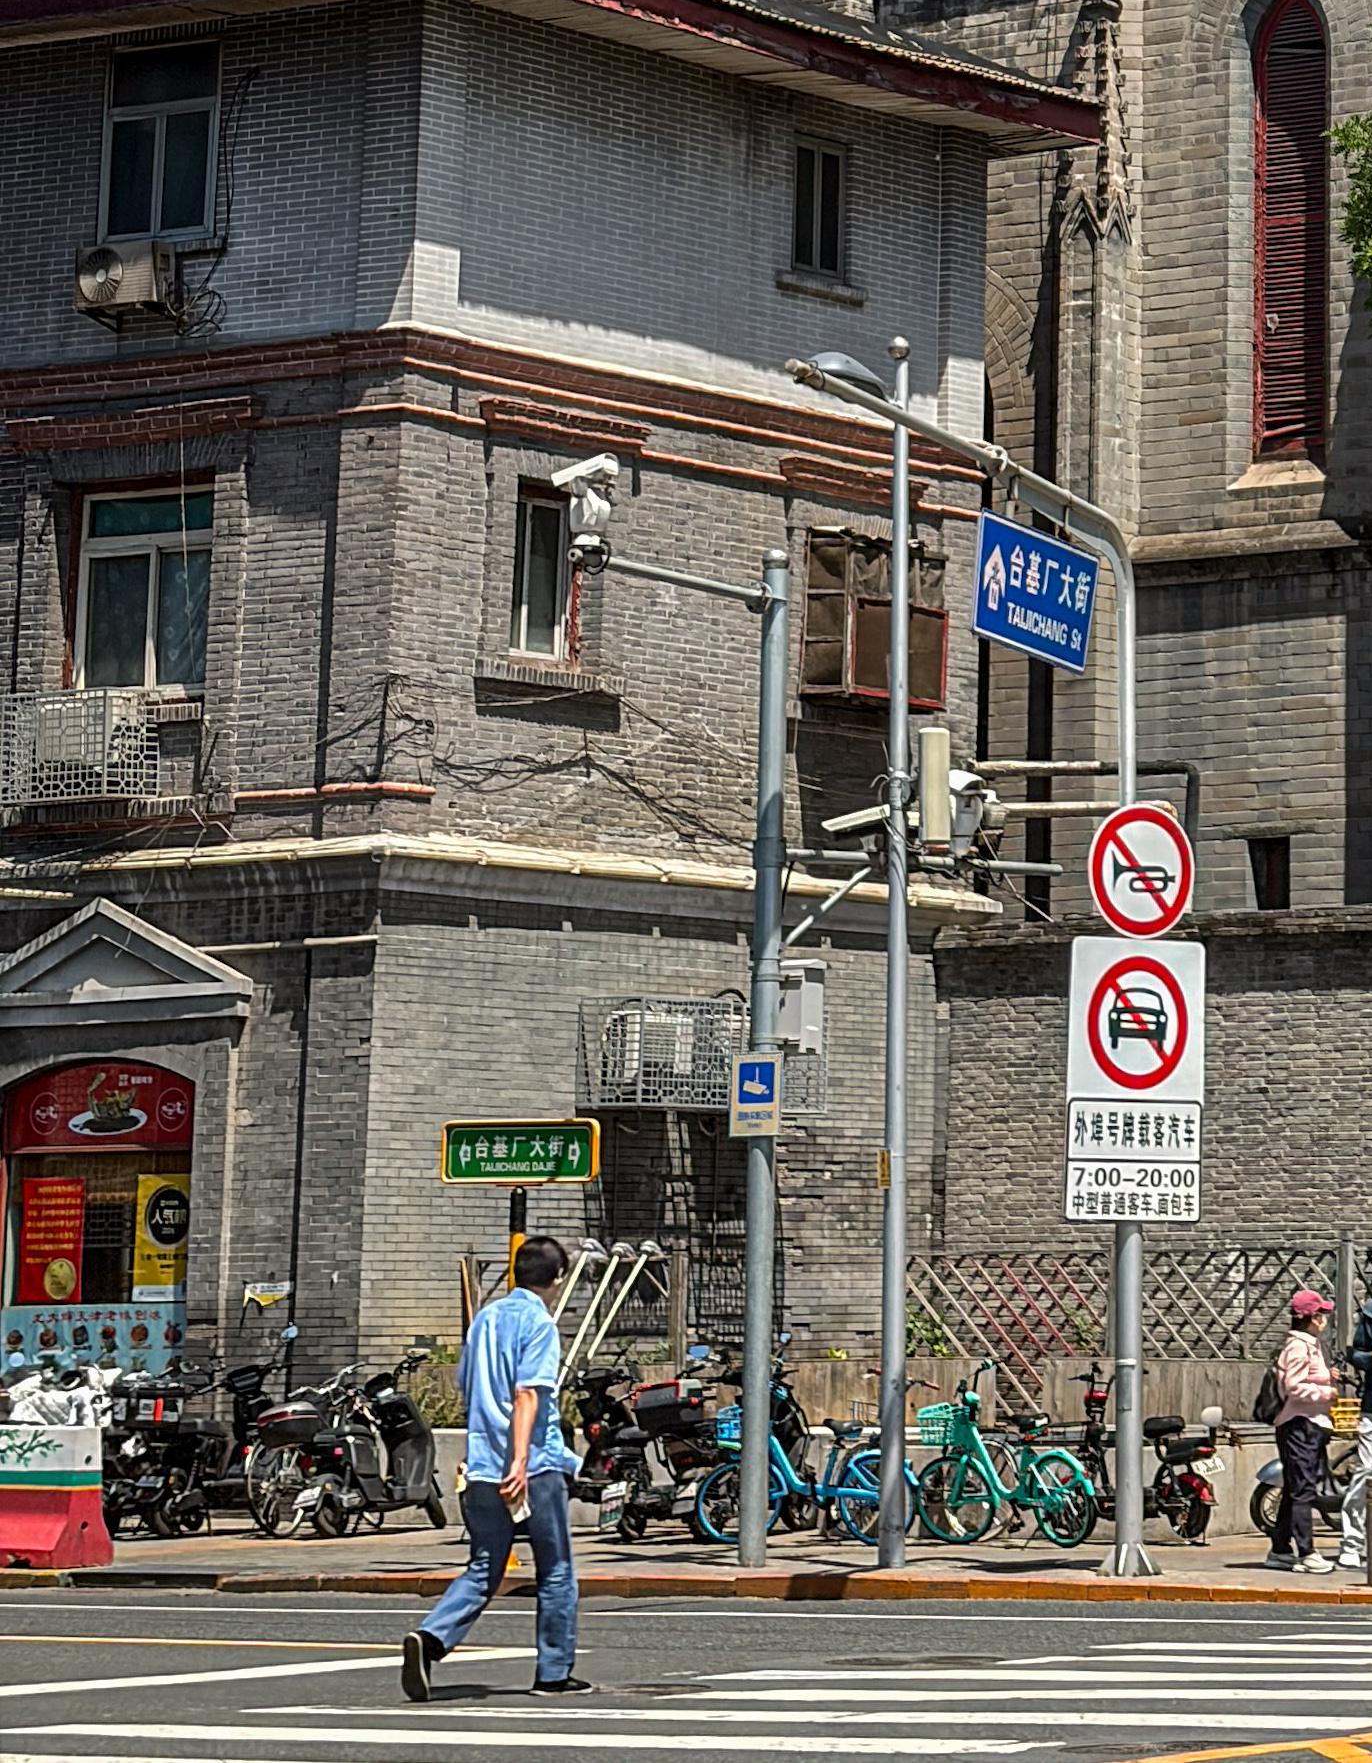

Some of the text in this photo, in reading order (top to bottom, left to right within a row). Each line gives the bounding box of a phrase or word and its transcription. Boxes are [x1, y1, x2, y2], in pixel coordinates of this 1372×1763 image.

[1009, 544, 1092, 615] 台基厂大街
[1007, 601, 1083, 652] TAIJICHANG St
[474, 1134, 565, 1159] 台基厂大街
[1074, 1110, 1196, 1149] 外埠号牌载客汽车
[479, 1161, 531, 1173] TAIJICHANG
